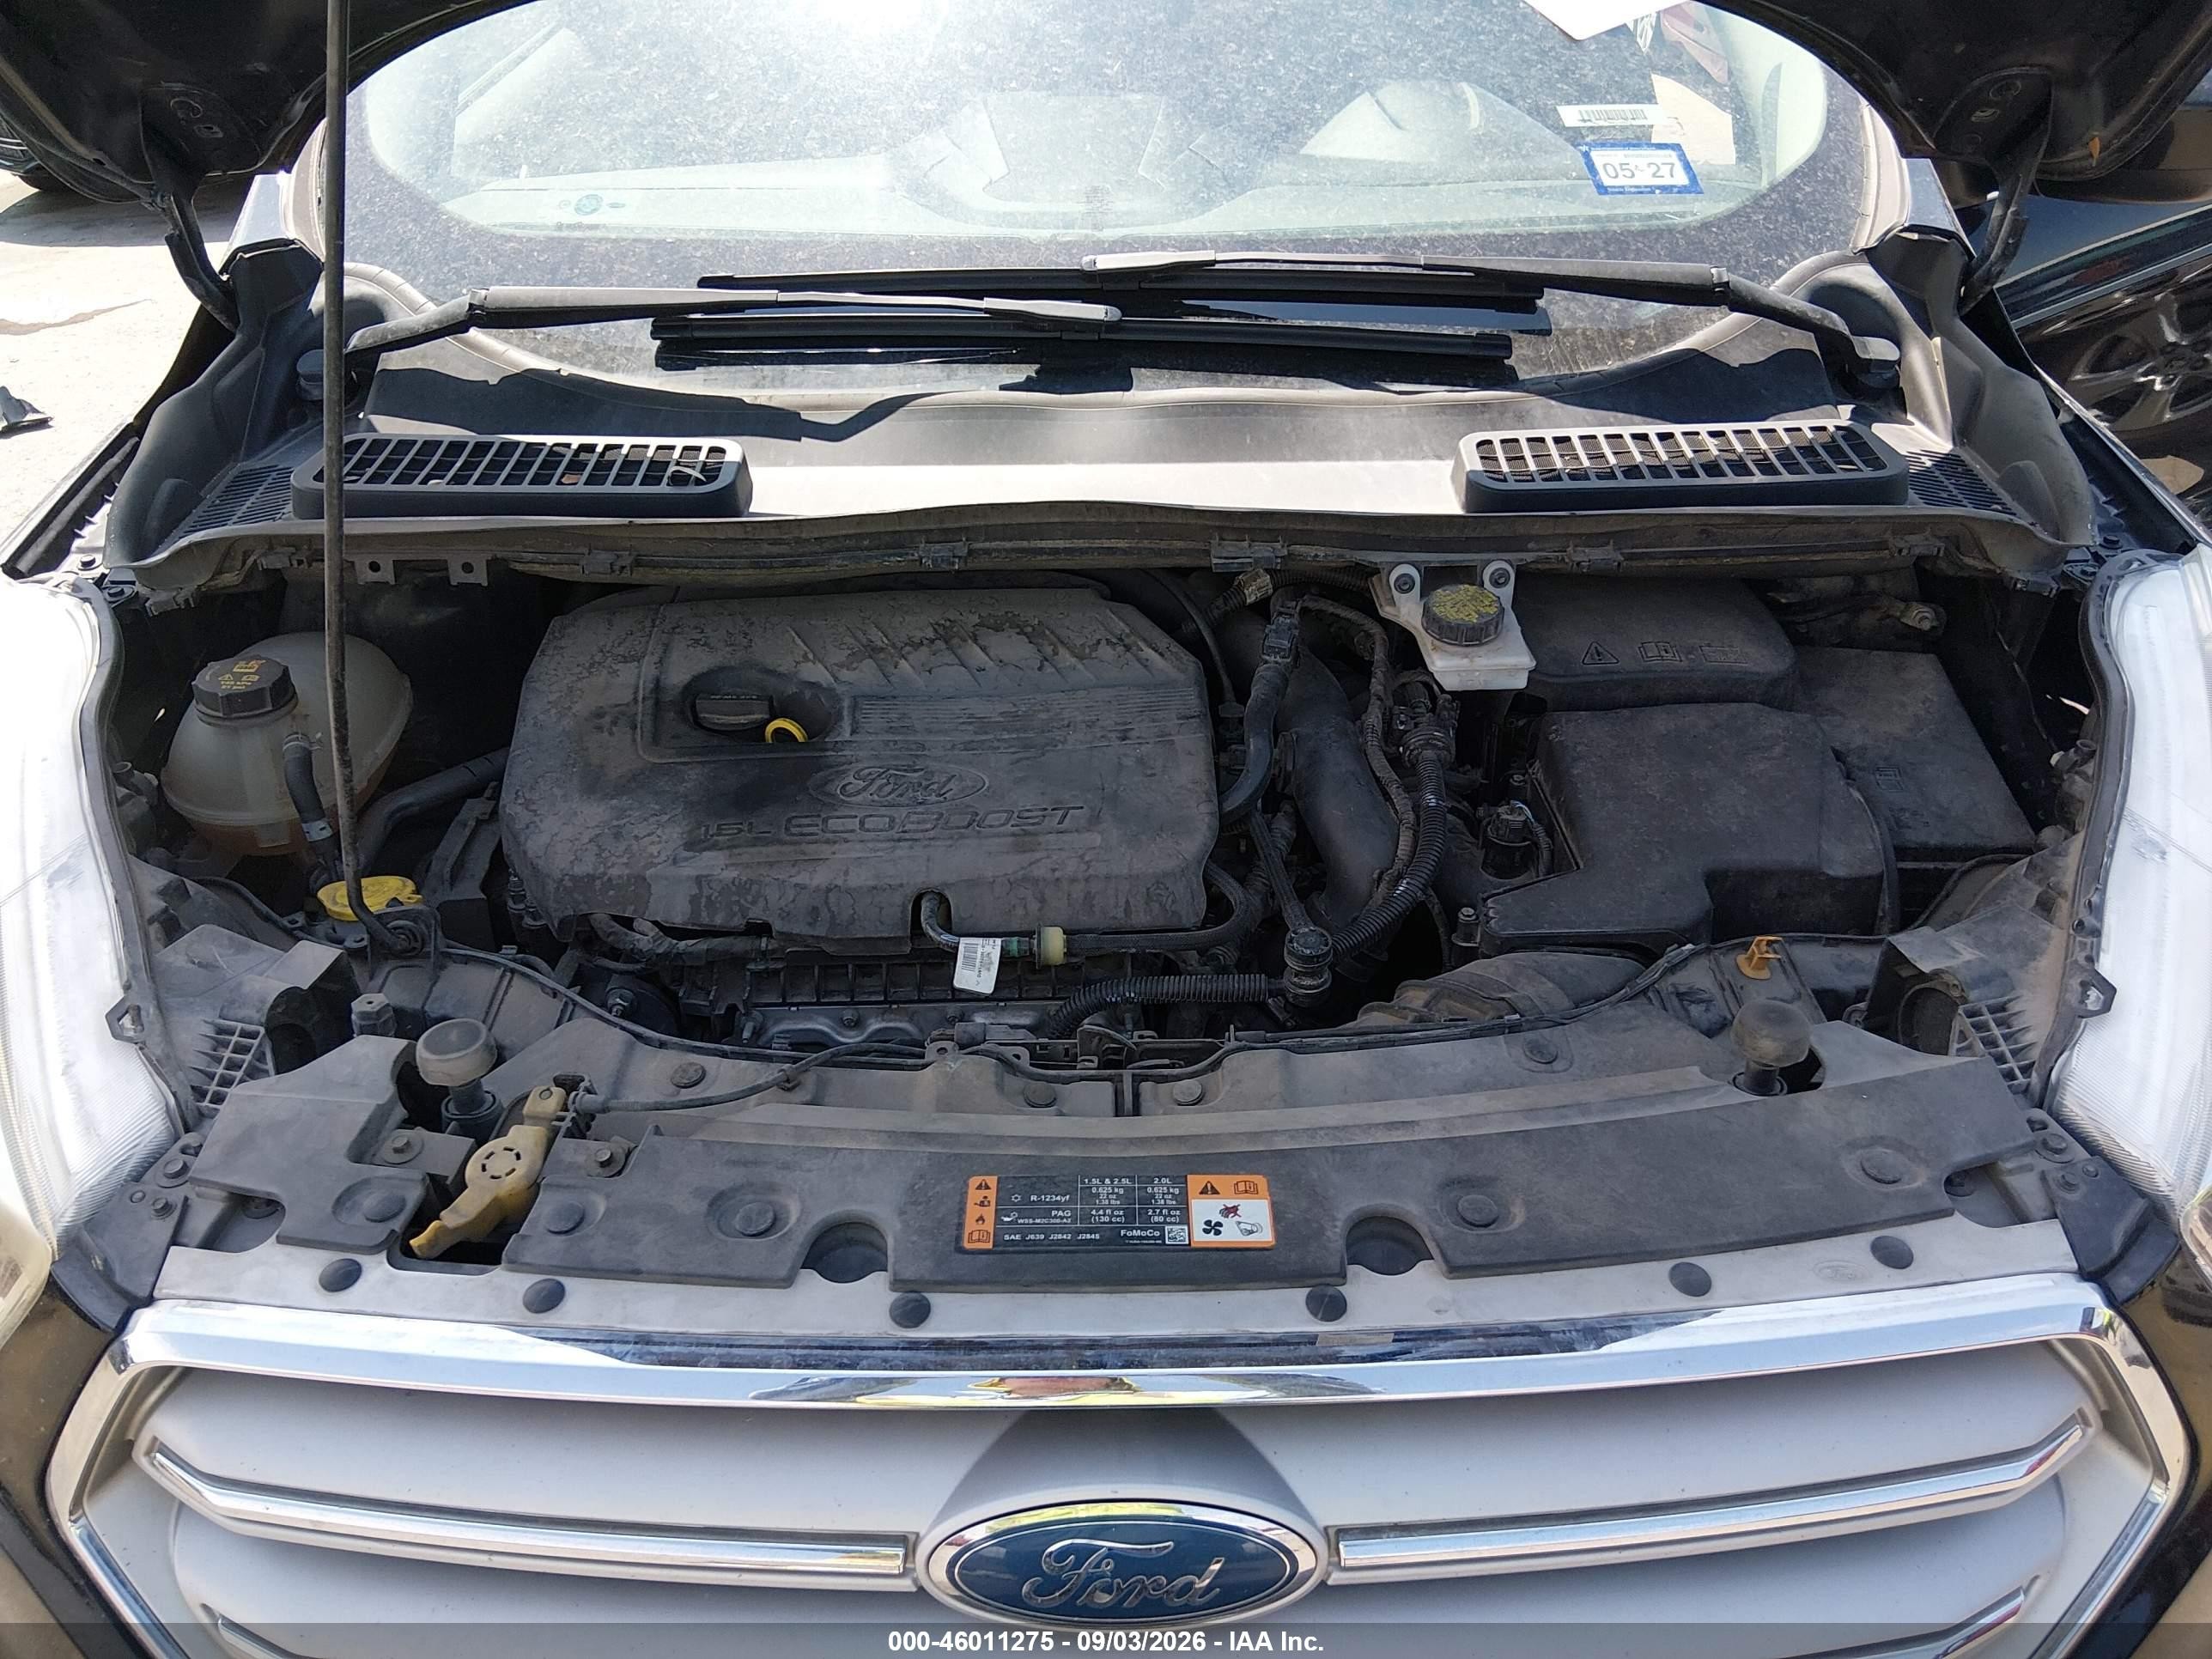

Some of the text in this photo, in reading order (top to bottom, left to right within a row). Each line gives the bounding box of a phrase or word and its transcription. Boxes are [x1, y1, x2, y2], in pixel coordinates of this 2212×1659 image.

[1602, 162, 1675, 179] 05 27
[835, 766, 958, 799] Ford
[783, 805, 1085, 838] ECOBOOST
[1022, 1538, 1225, 1609] Ford
